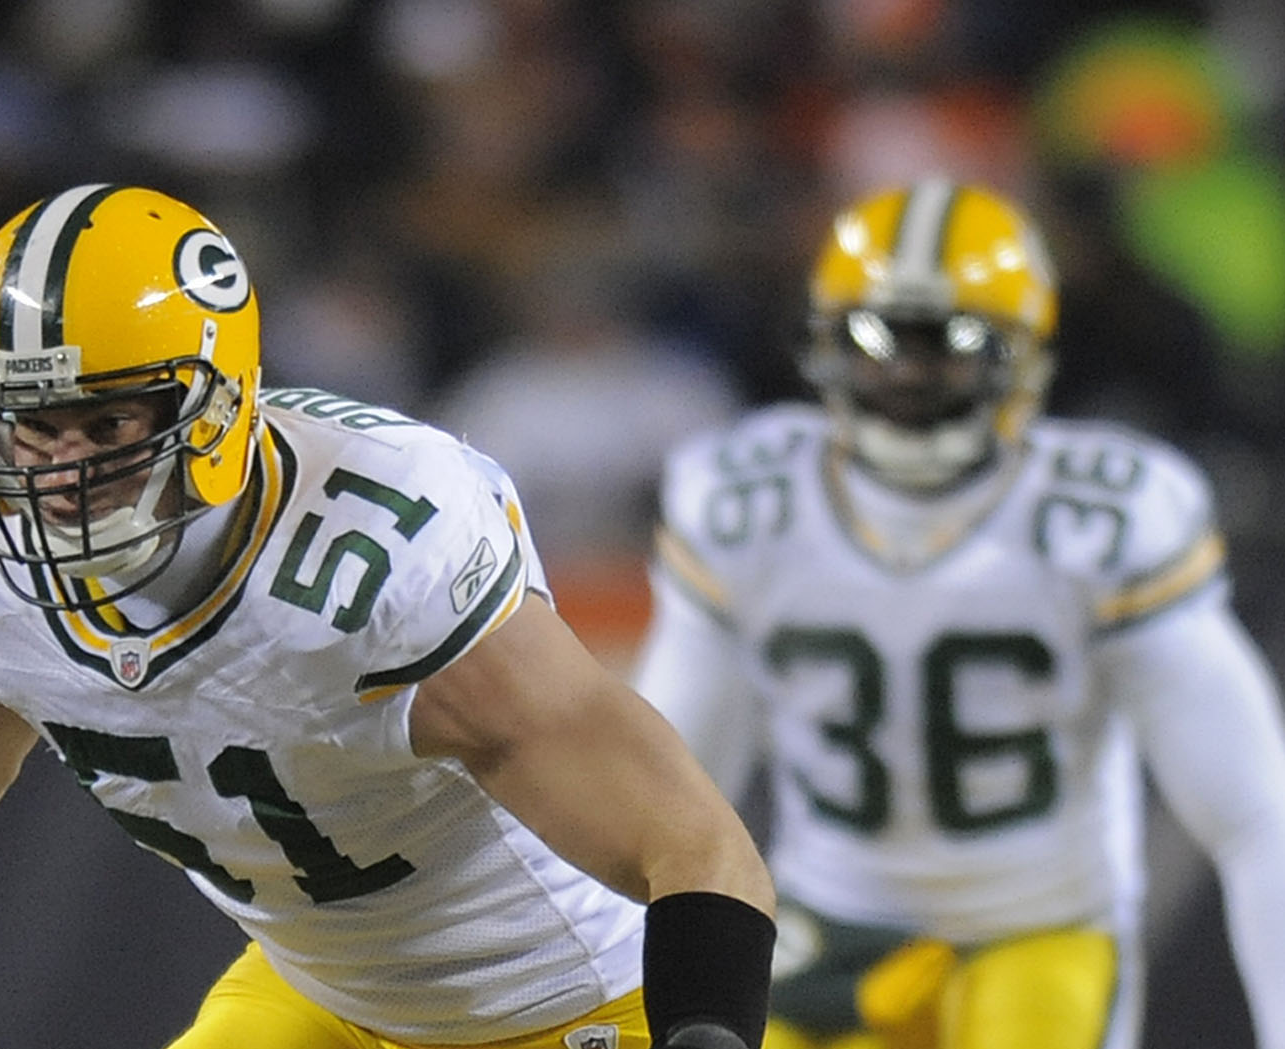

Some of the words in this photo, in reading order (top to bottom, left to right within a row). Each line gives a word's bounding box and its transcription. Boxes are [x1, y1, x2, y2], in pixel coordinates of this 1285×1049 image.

[269, 467, 439, 634] 51
[42, 721, 417, 903] 51
[765, 624, 1058, 836] 36
